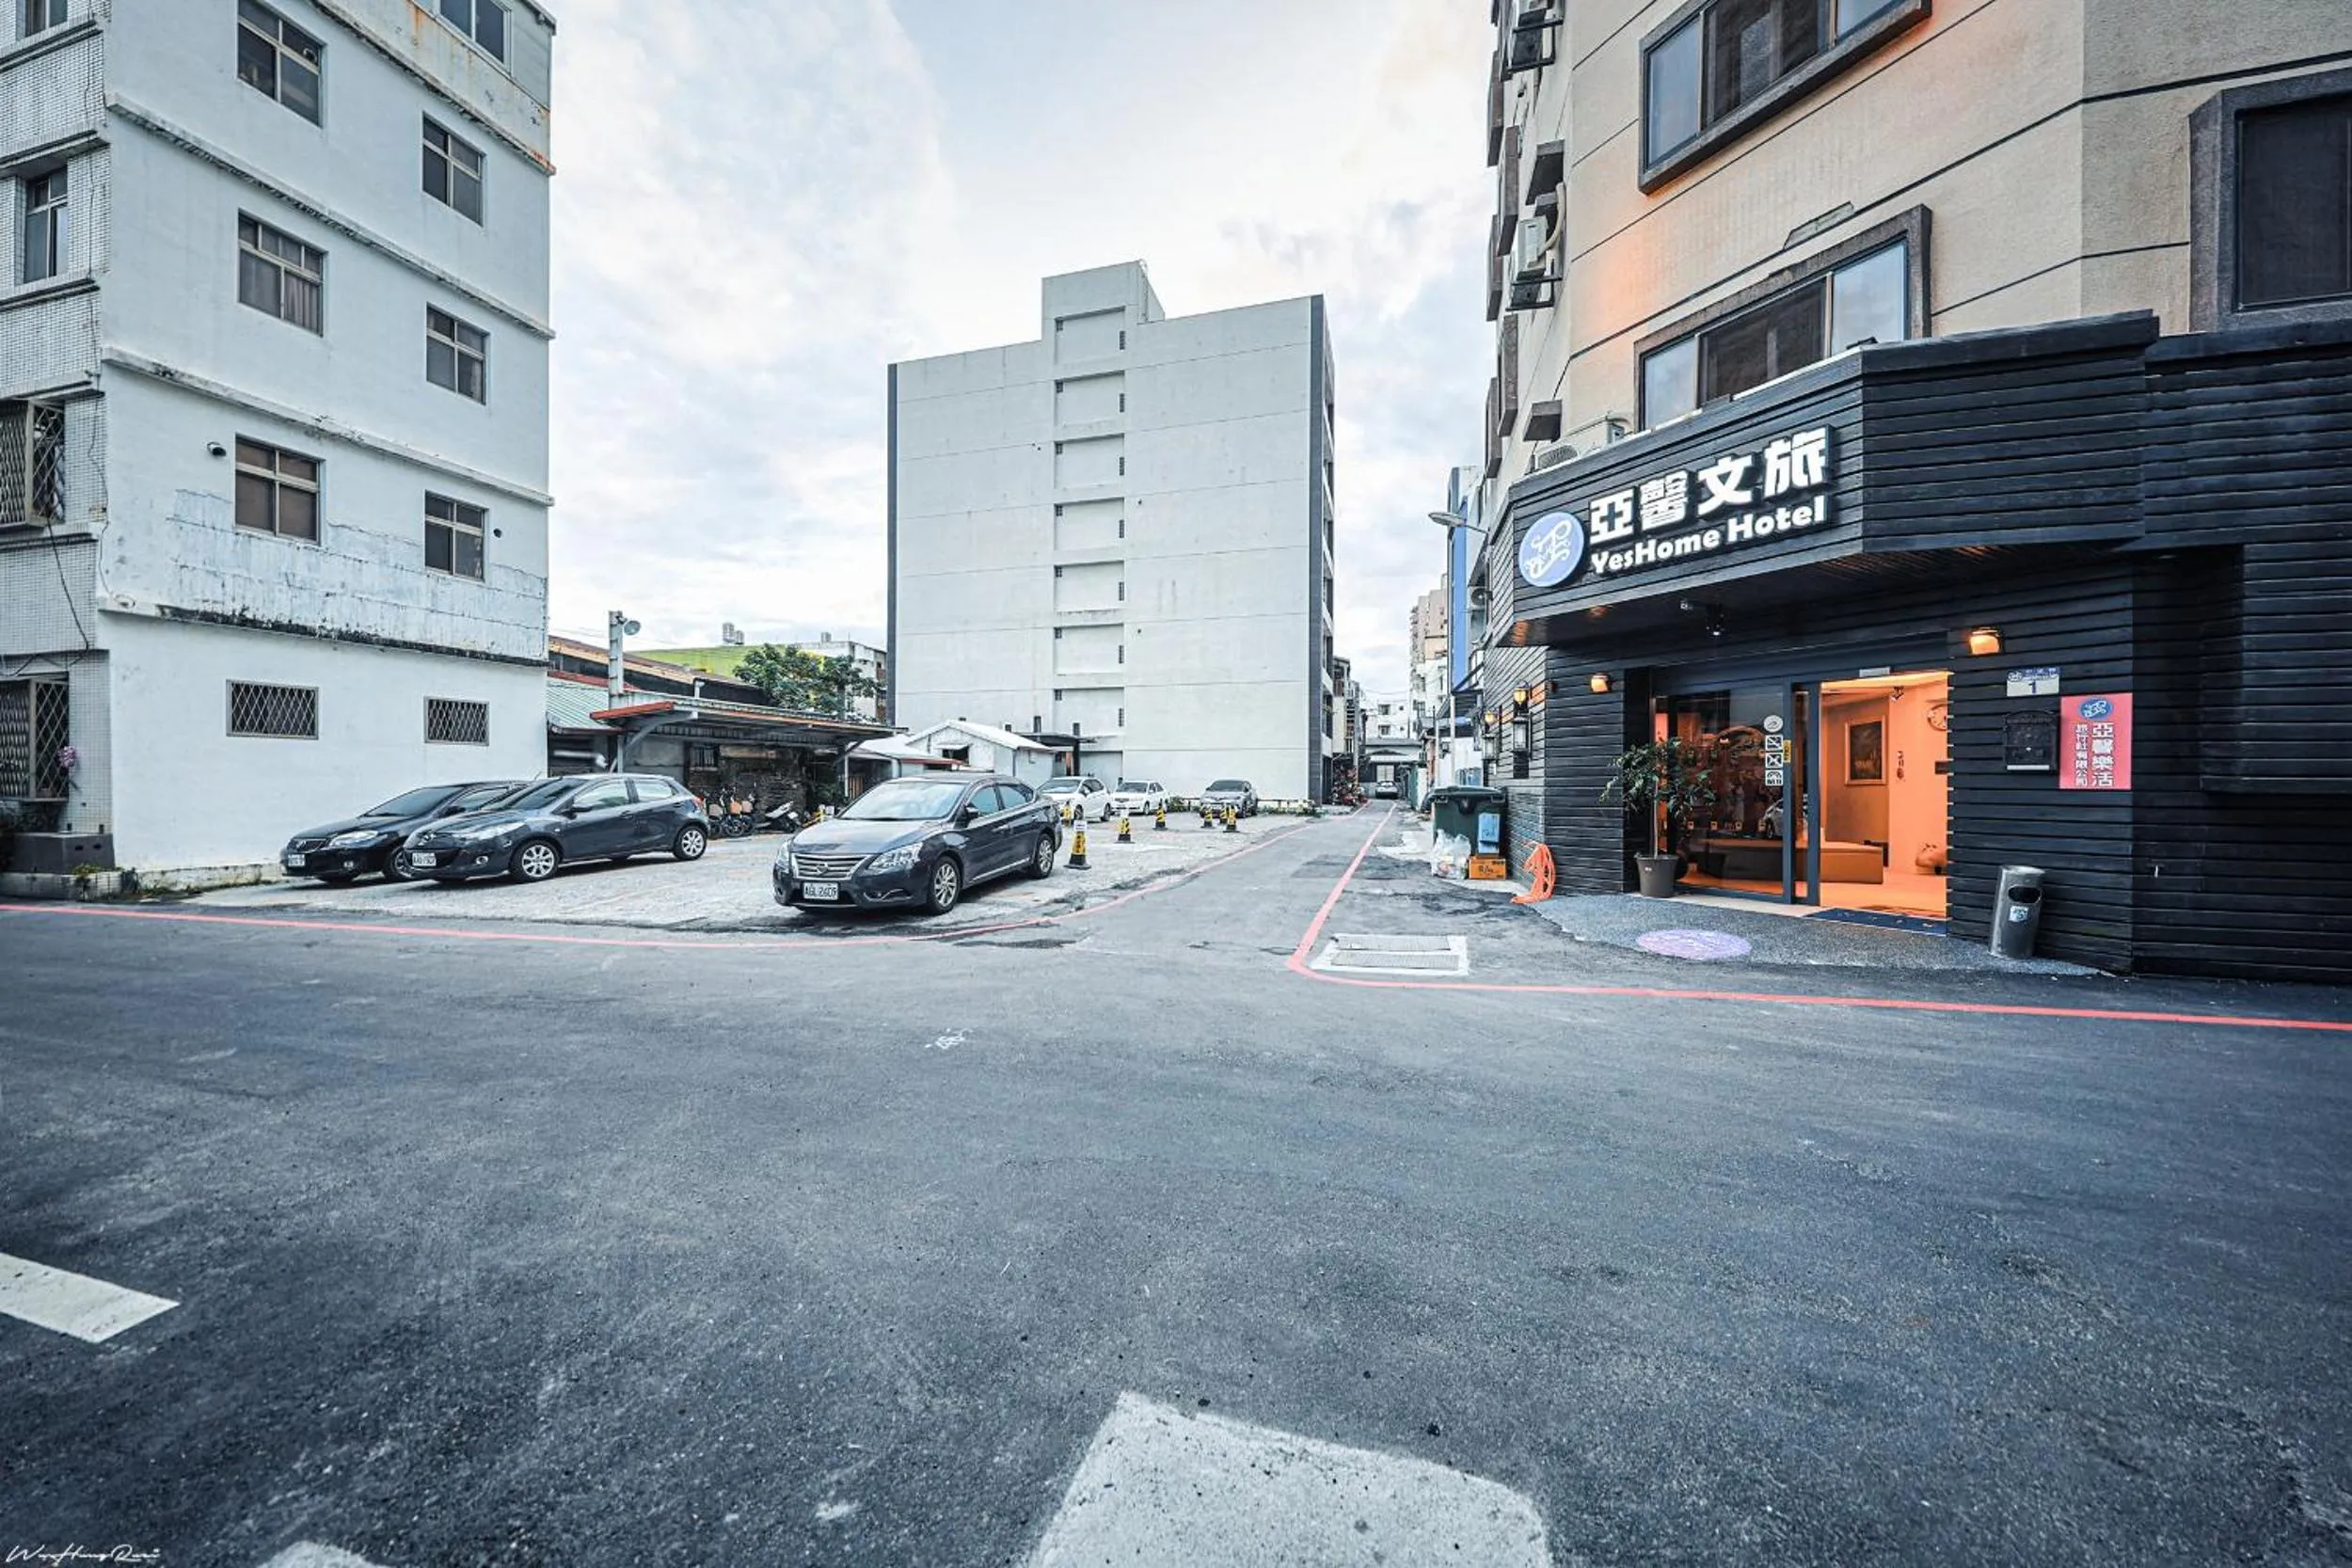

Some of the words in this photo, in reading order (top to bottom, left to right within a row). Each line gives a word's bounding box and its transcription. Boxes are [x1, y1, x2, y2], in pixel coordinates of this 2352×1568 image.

[1589, 427, 1828, 545] 亞馨文旅
[1591, 529, 1720, 575] YesHome
[1727, 496, 1826, 544] Hotel
